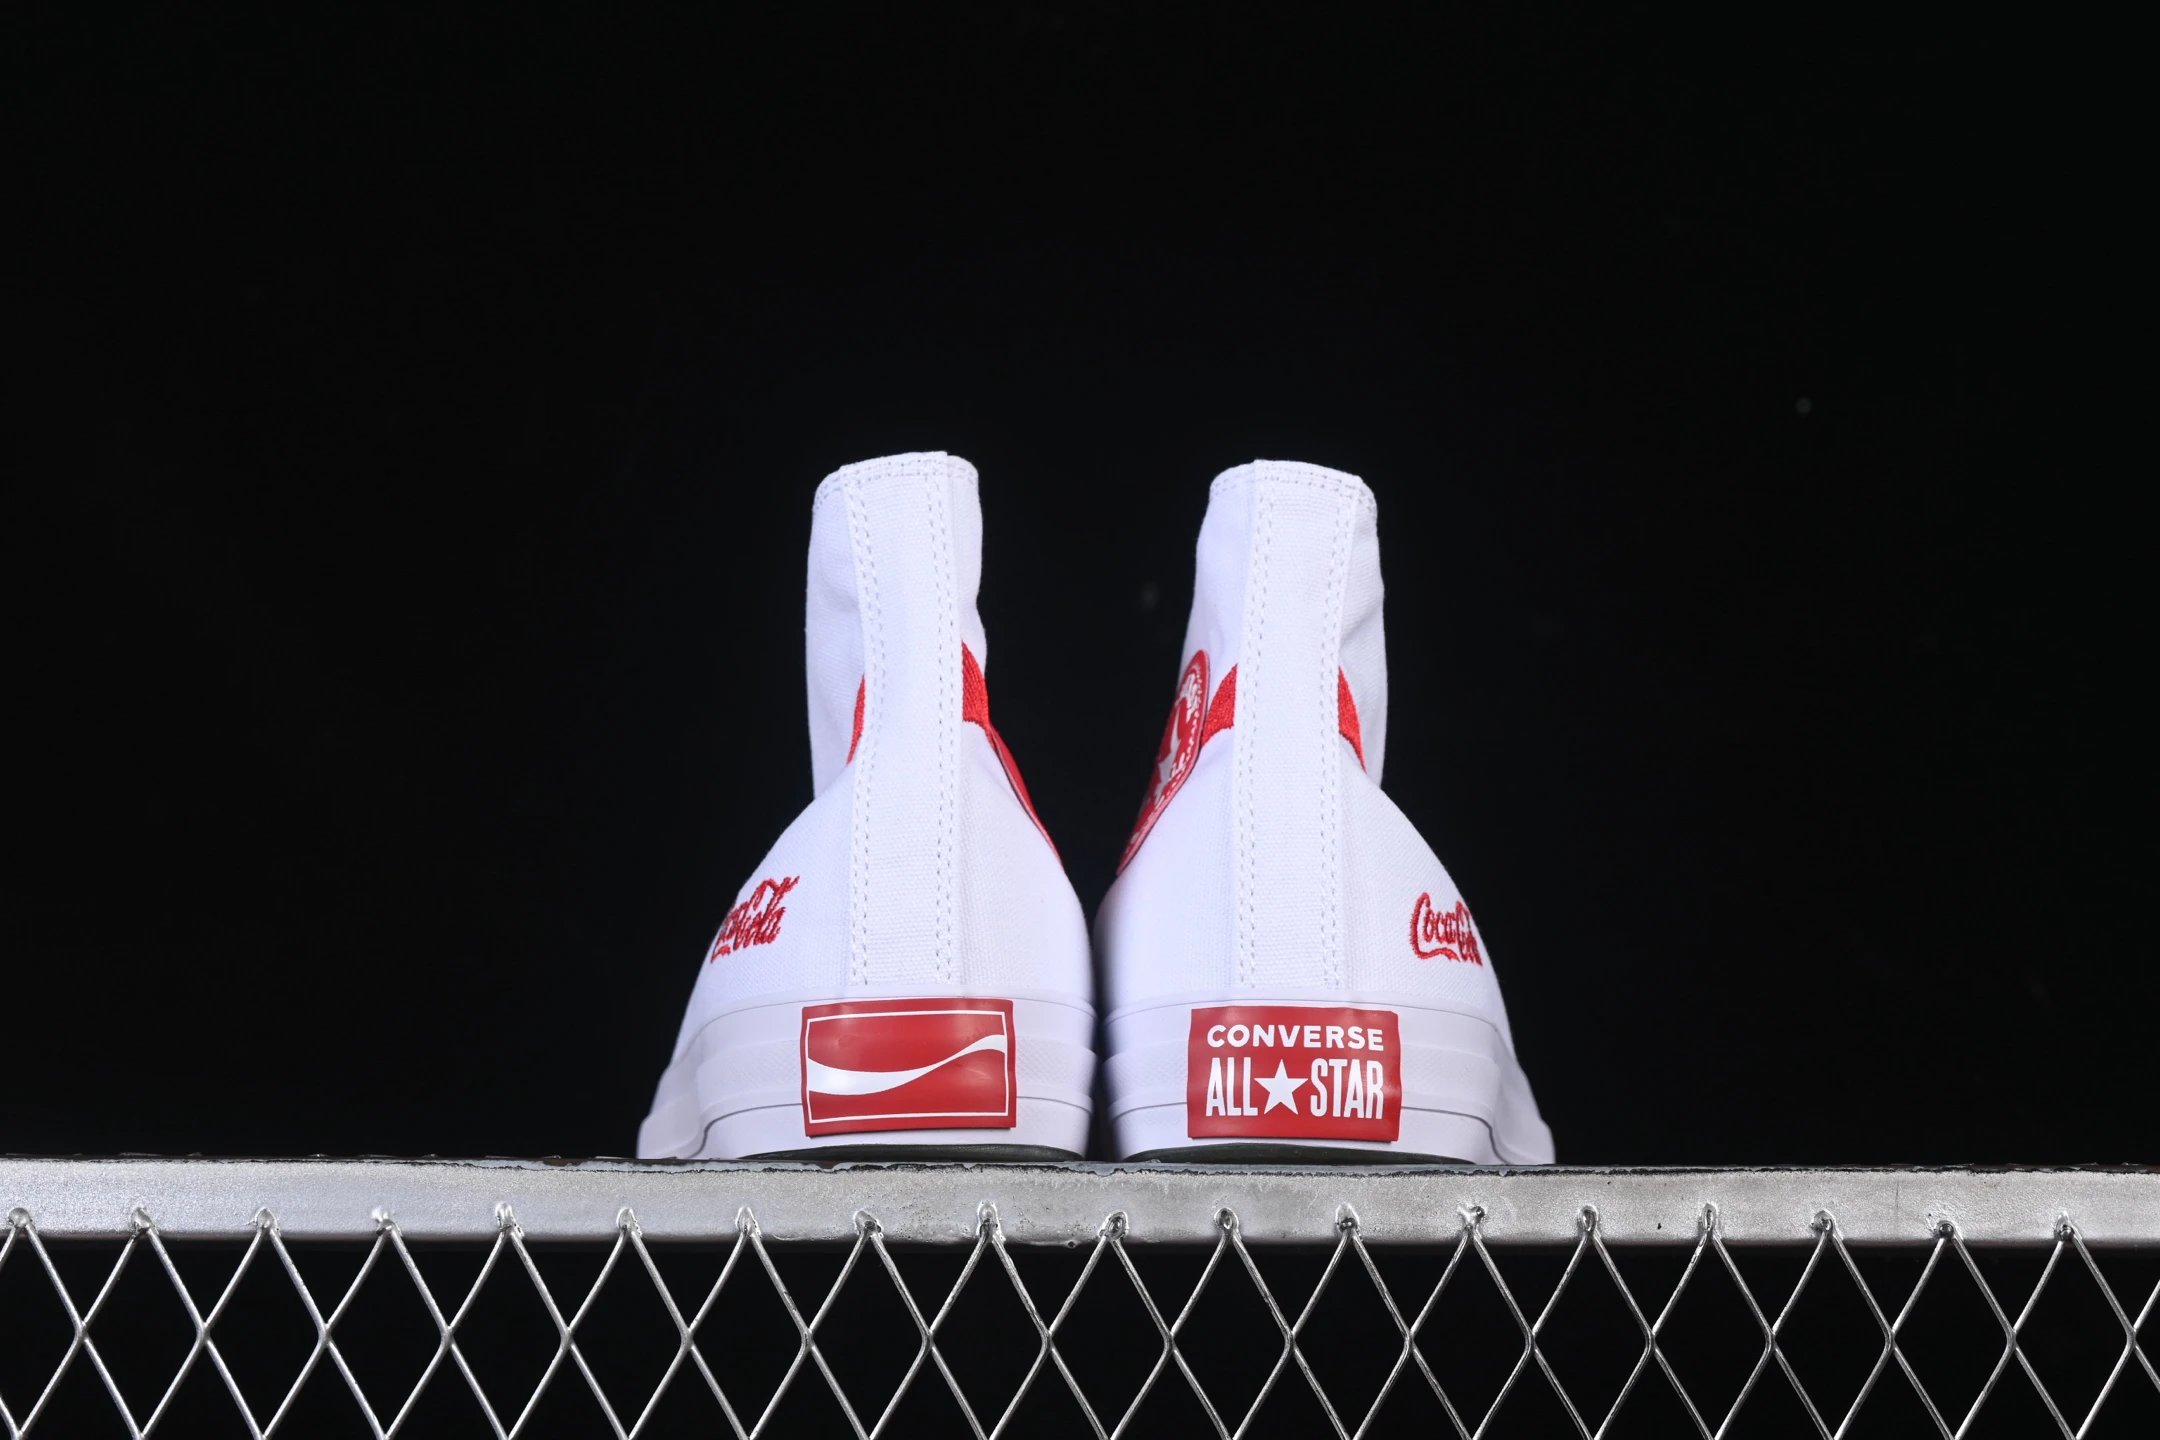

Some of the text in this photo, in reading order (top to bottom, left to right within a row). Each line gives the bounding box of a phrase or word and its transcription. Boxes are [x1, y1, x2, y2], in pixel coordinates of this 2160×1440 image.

[1207, 1024, 1384, 1051] CONVERSE
[1206, 1057, 1384, 1120] ALL STAR
